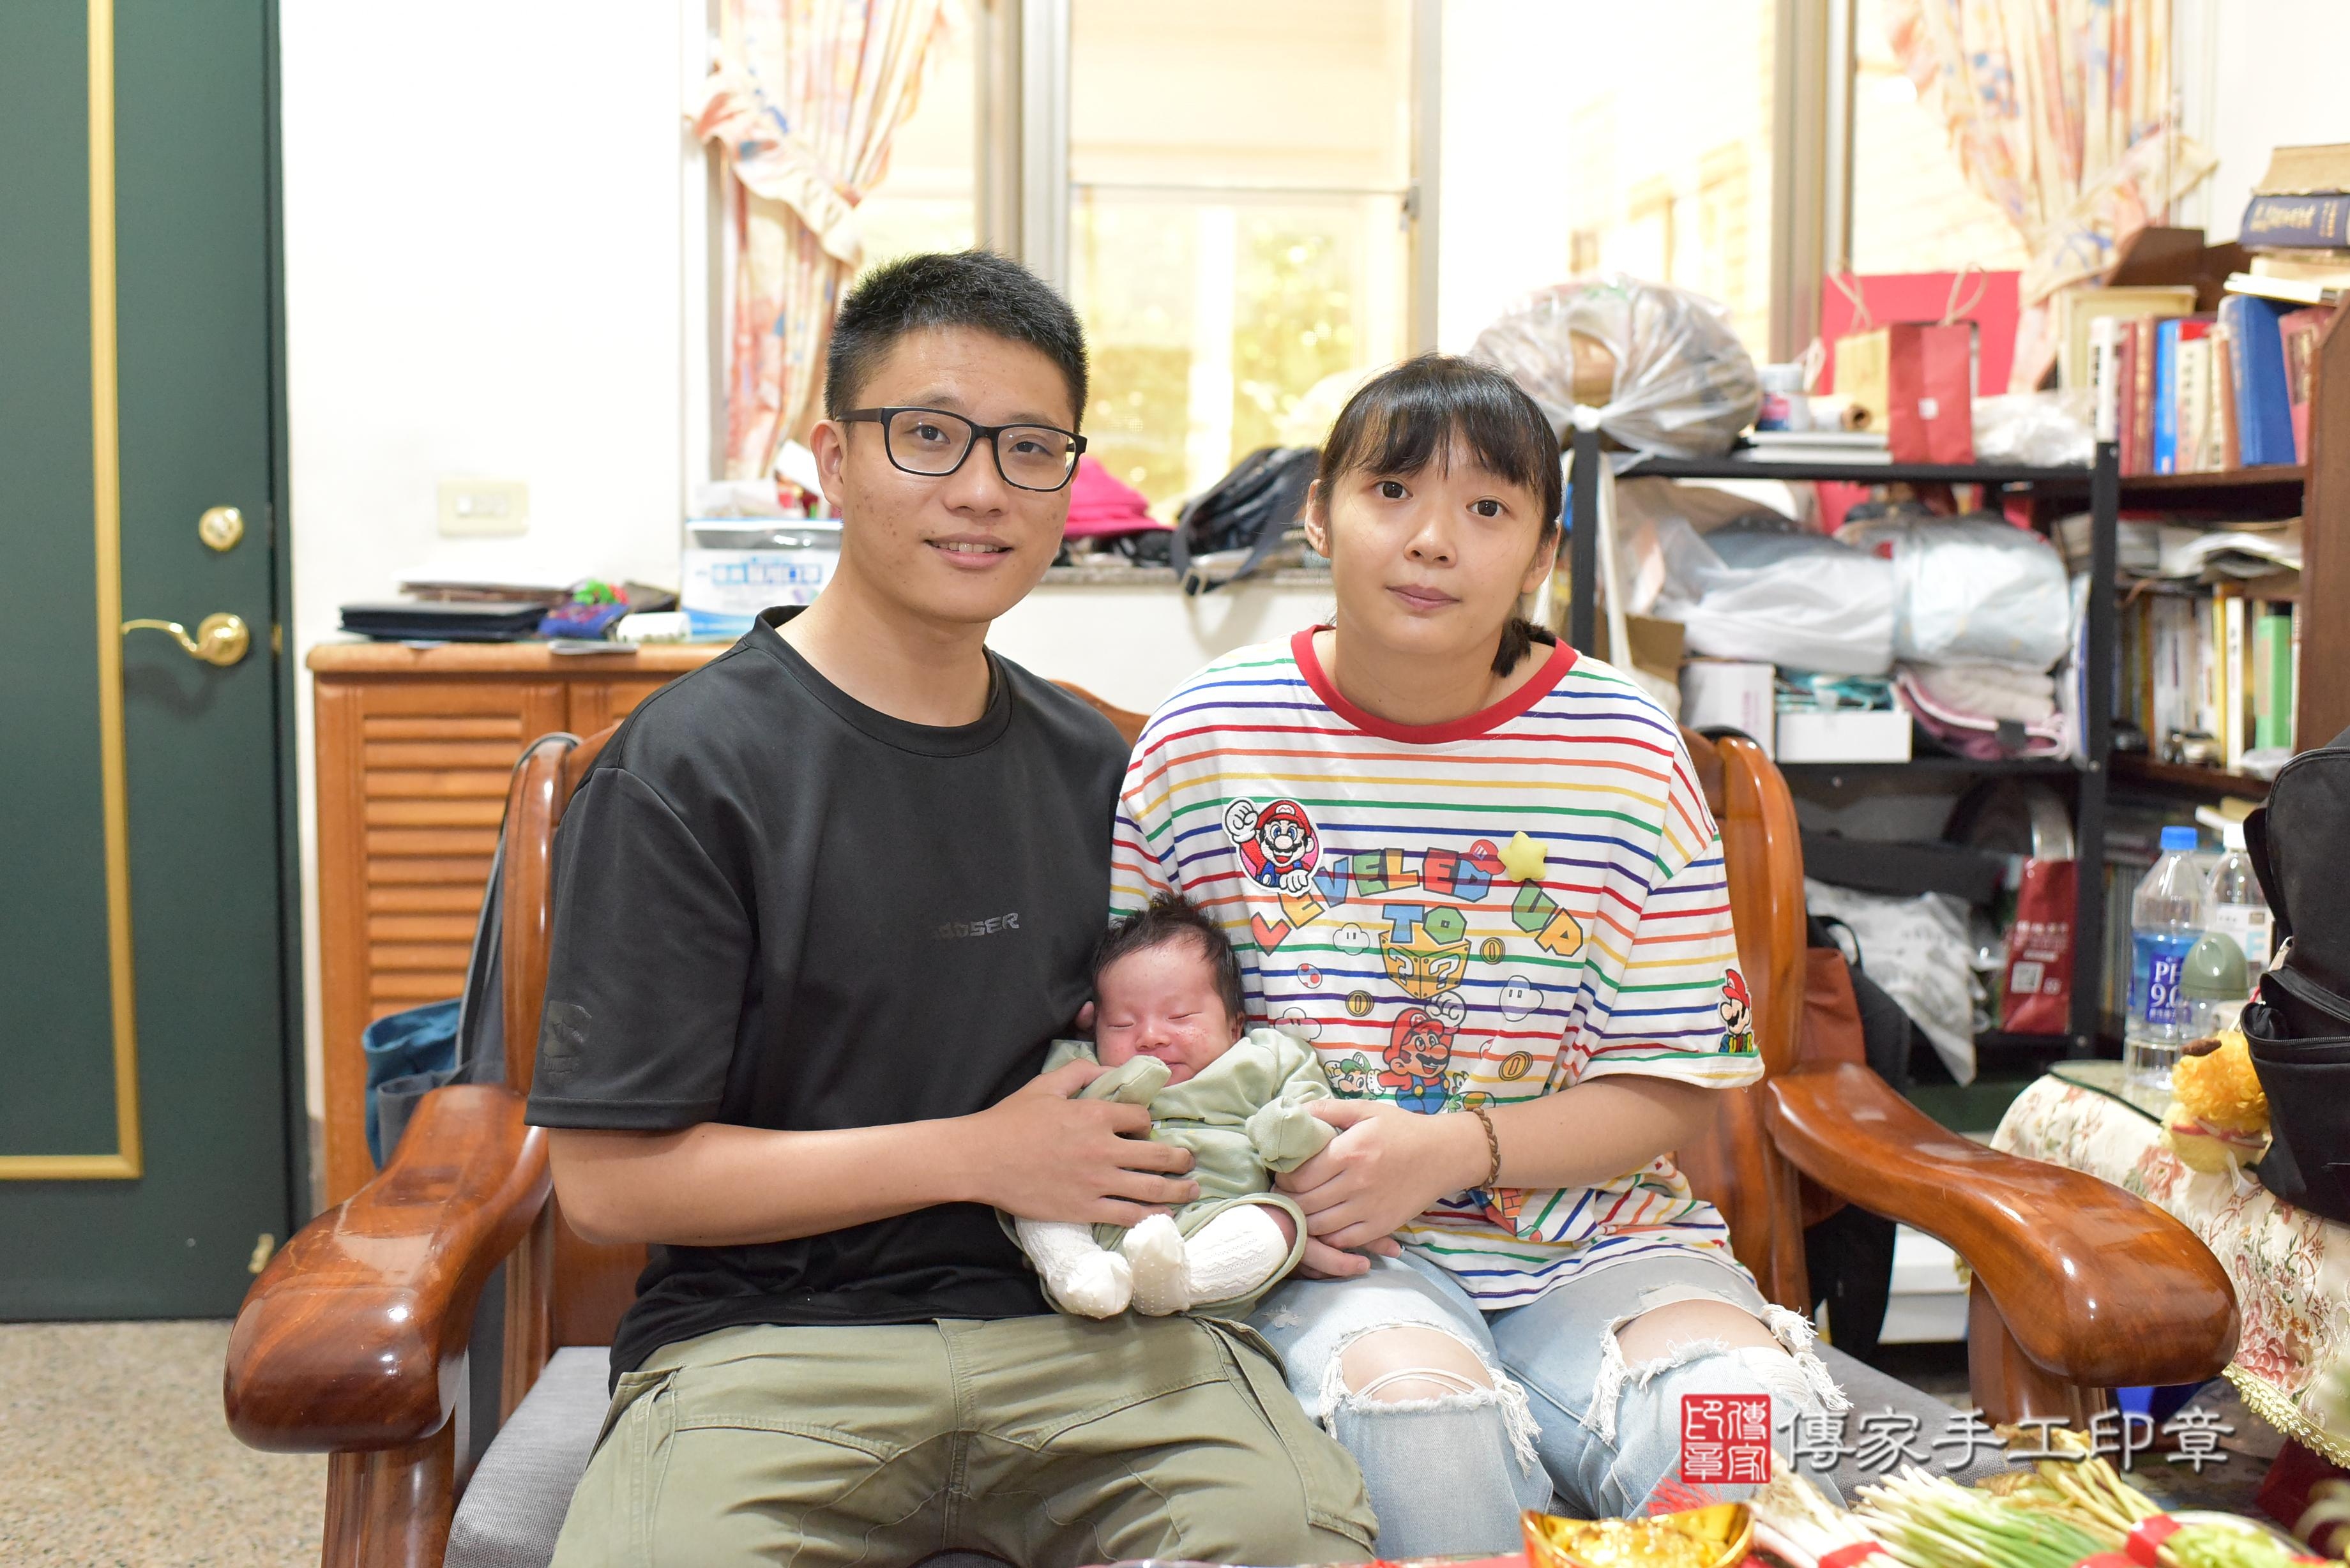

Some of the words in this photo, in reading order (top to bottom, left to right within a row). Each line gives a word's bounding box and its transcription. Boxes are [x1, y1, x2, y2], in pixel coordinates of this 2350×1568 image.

[1250, 847, 1493, 957] LEVELED
[1511, 878, 1584, 958] UP
[1382, 903, 1468, 946] TO
